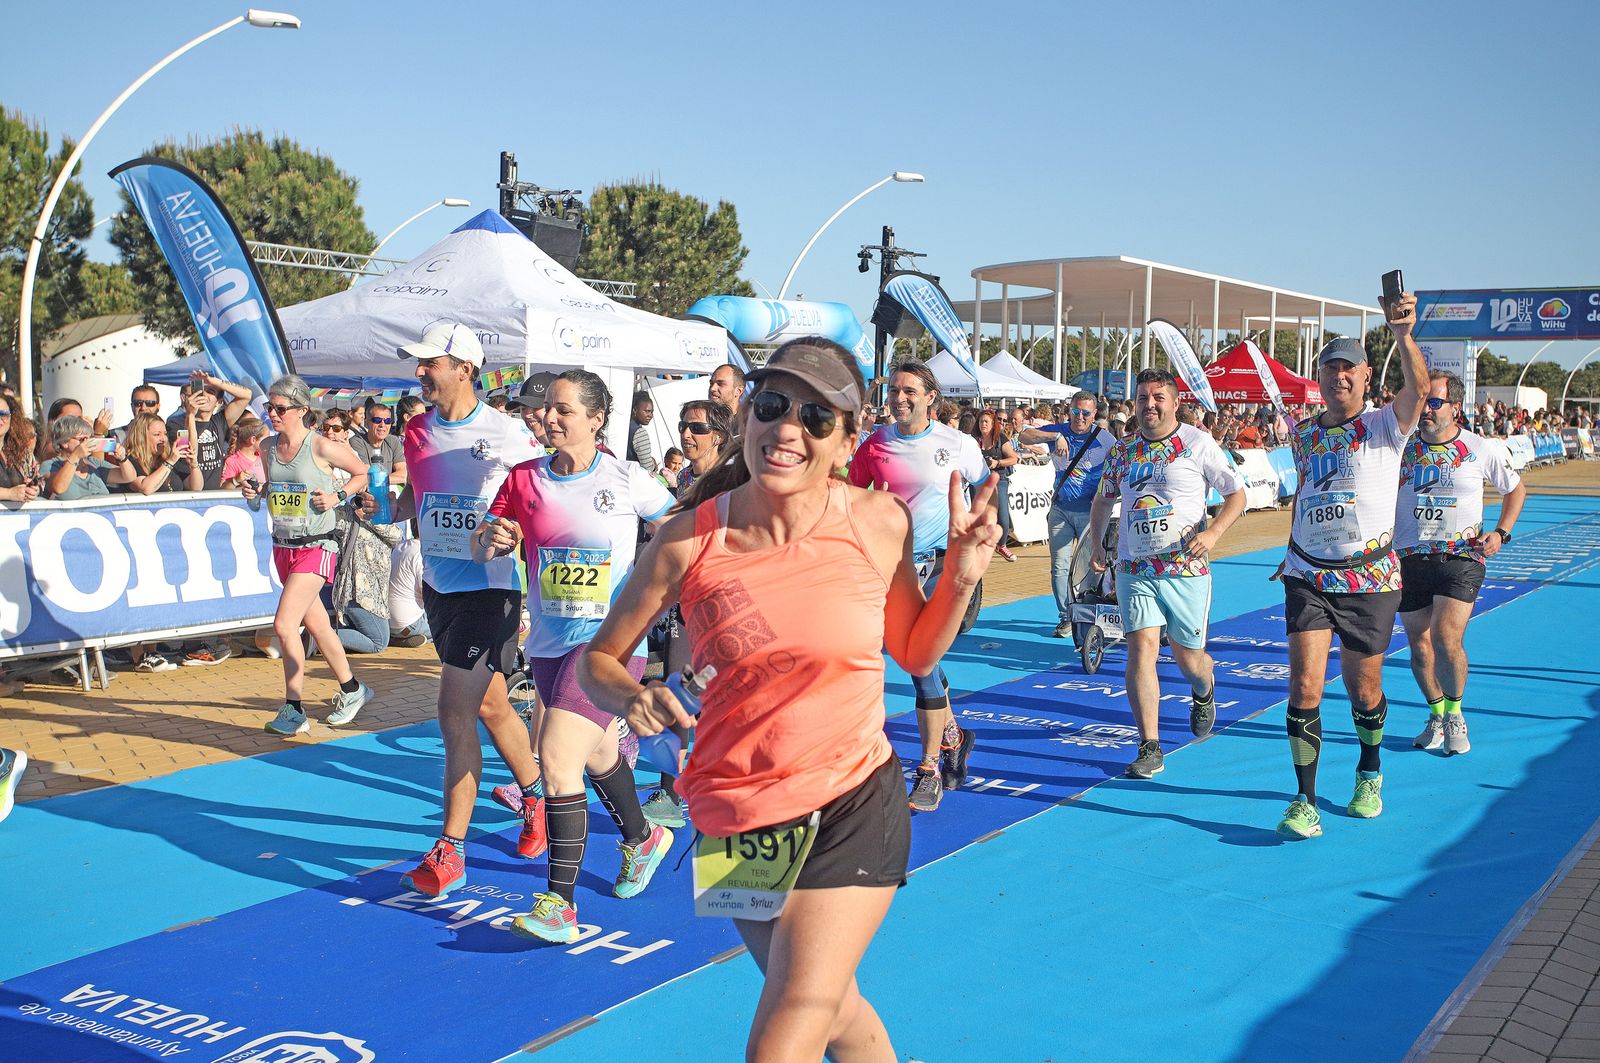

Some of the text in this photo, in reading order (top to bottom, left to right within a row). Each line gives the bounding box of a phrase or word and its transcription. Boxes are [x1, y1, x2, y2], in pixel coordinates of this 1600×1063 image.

[373, 284, 448, 297] cepaim
[790, 309, 822, 327] HUELVA
[1490, 298, 1518, 332] 10
[1309, 451, 1338, 491] 10
[1413, 464, 1441, 494] 10
[271, 494, 301, 507] 1346
[463, 499, 479, 509] 202
[430, 510, 477, 531] 1536
[1307, 505, 1345, 525] 1880
[1134, 519, 1169, 535] 1675
[584, 553, 605, 562] 2023
[550, 566, 599, 586] 1222
[1103, 613, 1122, 624] 160
[961, 709, 1075, 727] HUELVA
[718, 830, 796, 864] 1591
[751, 869, 770, 878] TERE
[727, 879, 760, 889] REVILLA
[707, 901, 744, 910] HYUNDAI
[59, 983, 247, 1044] HUELVA
[18, 1002, 192, 1057] Ayuntamiento de
